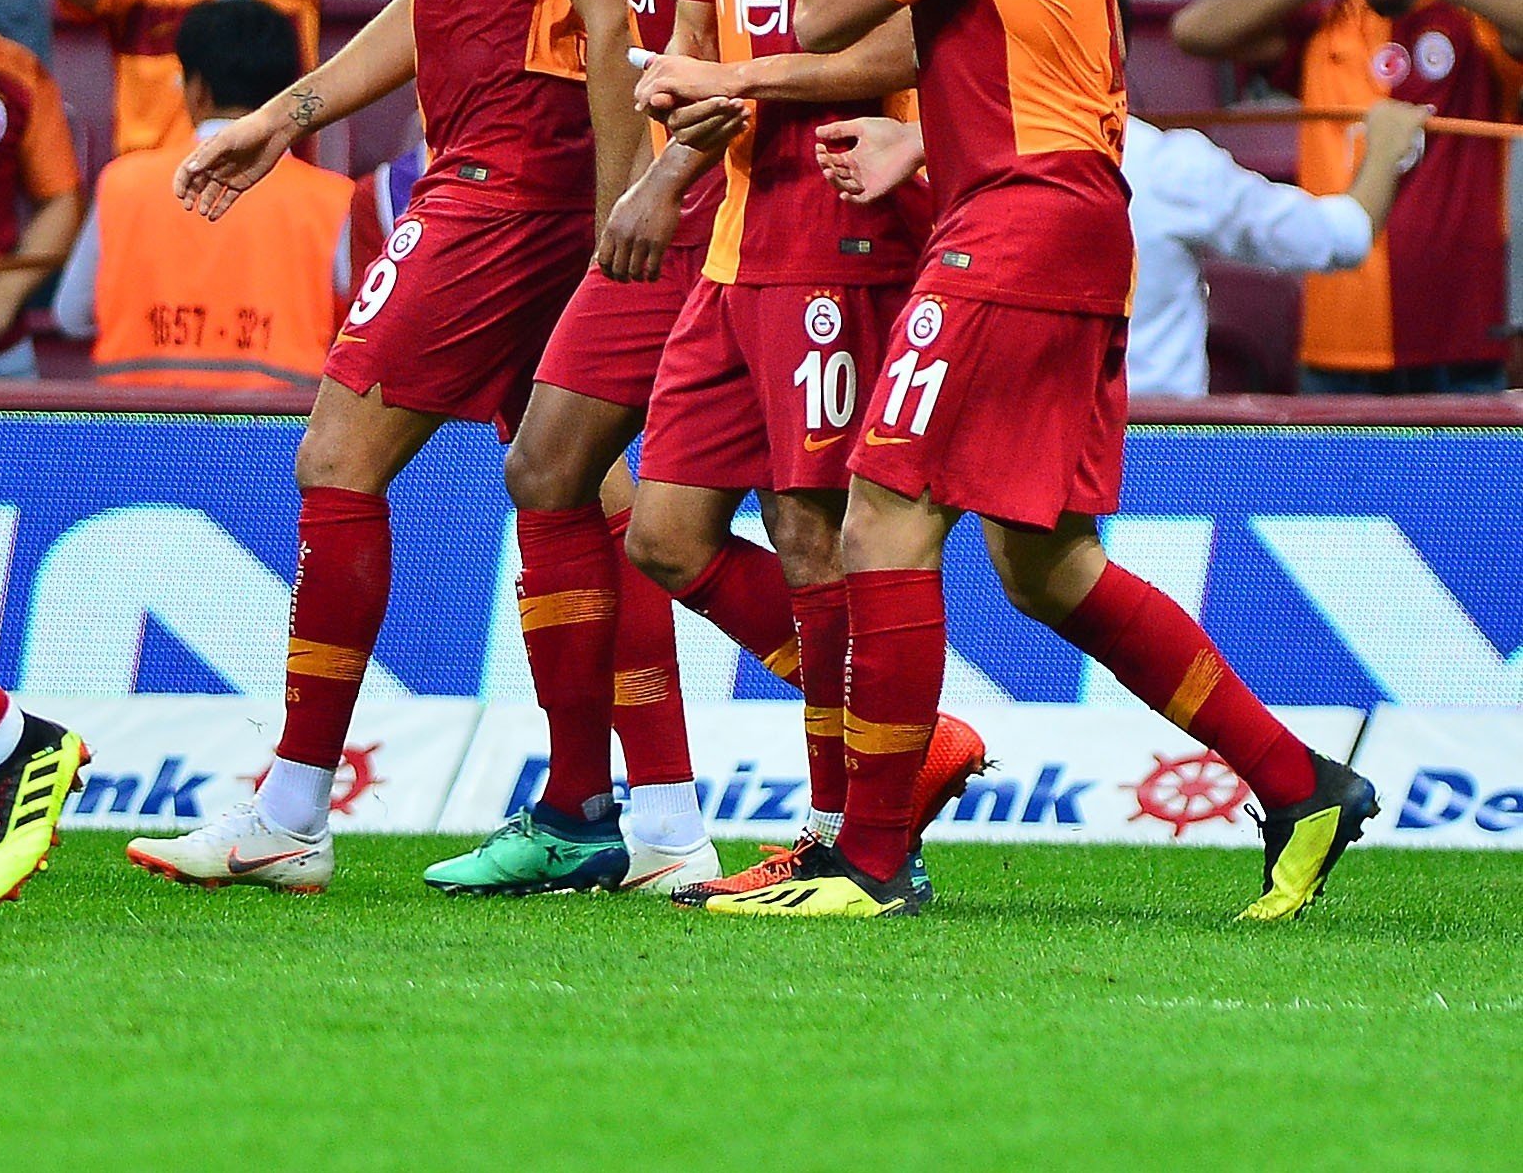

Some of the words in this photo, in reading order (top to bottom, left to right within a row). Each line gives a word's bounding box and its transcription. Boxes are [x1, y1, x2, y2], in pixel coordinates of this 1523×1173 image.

[349, 257, 398, 325] 9
[793, 350, 857, 429] 10
[883, 348, 949, 436] 11
